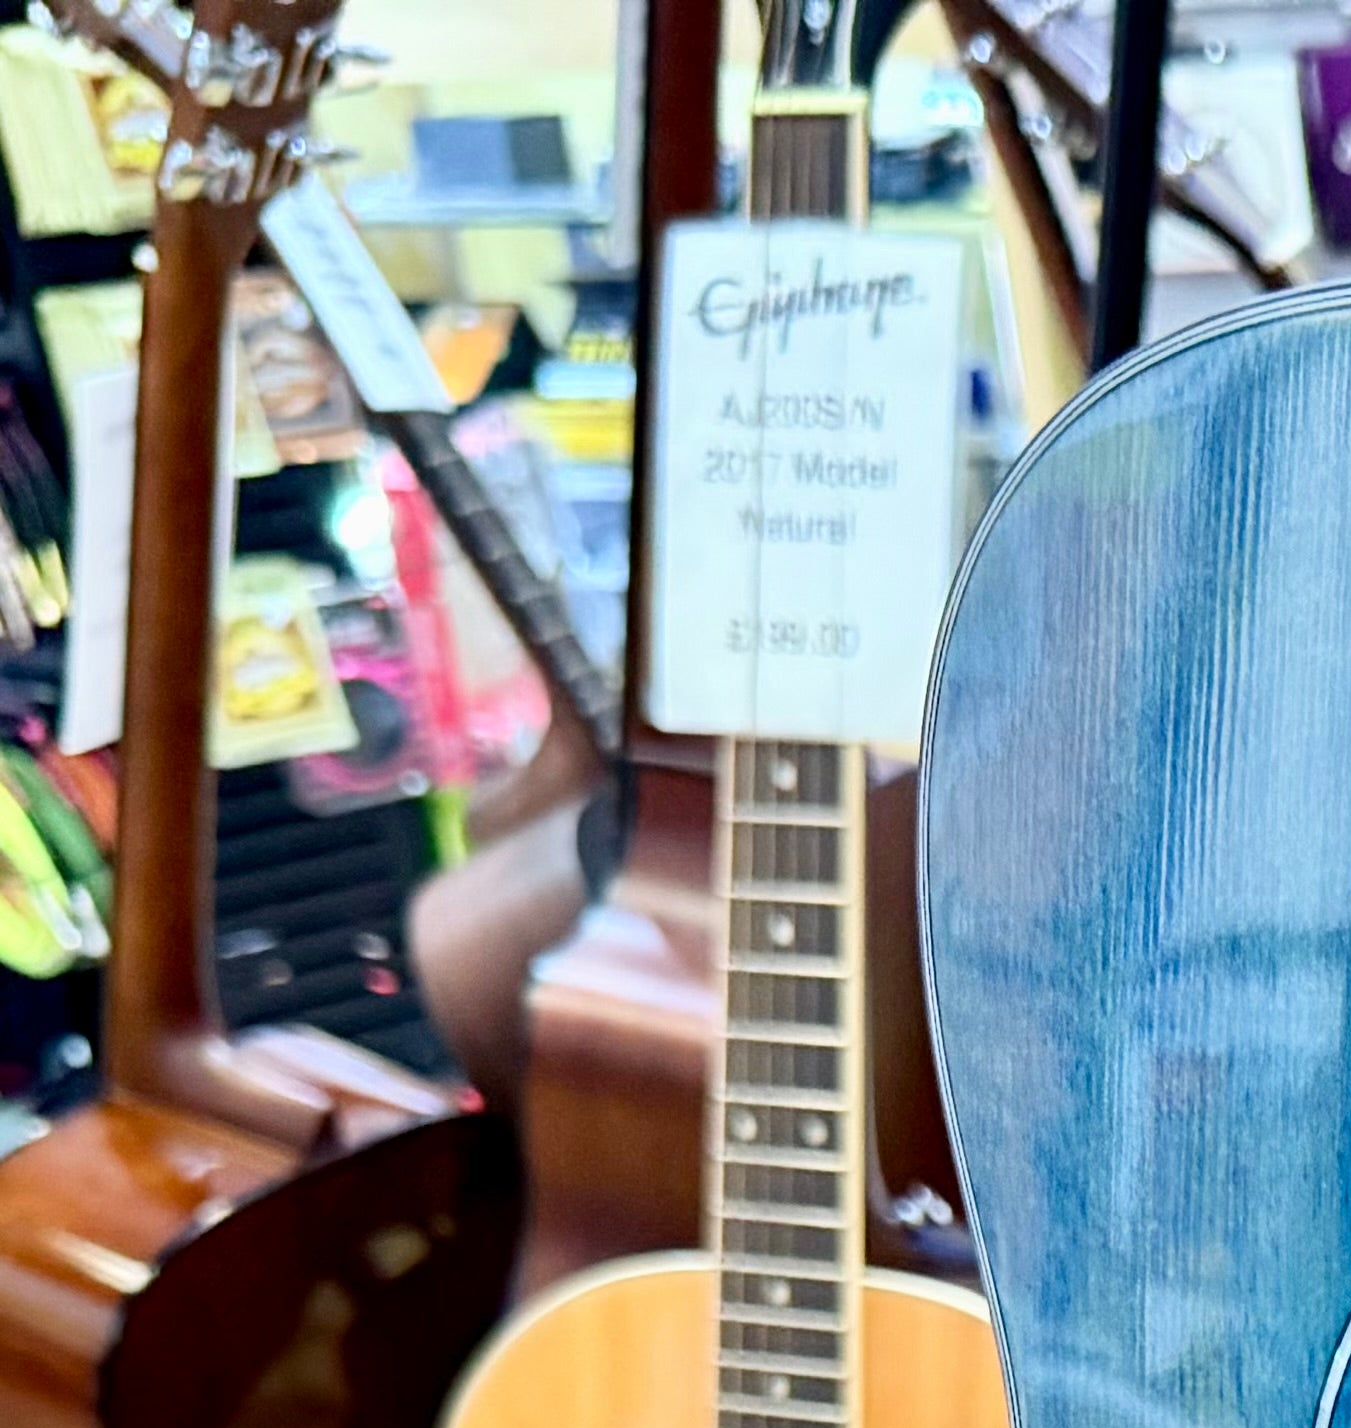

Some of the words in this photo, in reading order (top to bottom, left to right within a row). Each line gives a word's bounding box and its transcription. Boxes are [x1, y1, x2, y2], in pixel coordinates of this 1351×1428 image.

[689, 256, 924, 361] Epiphone
[790, 451, 898, 489] Model
[736, 504, 857, 546] Natural
